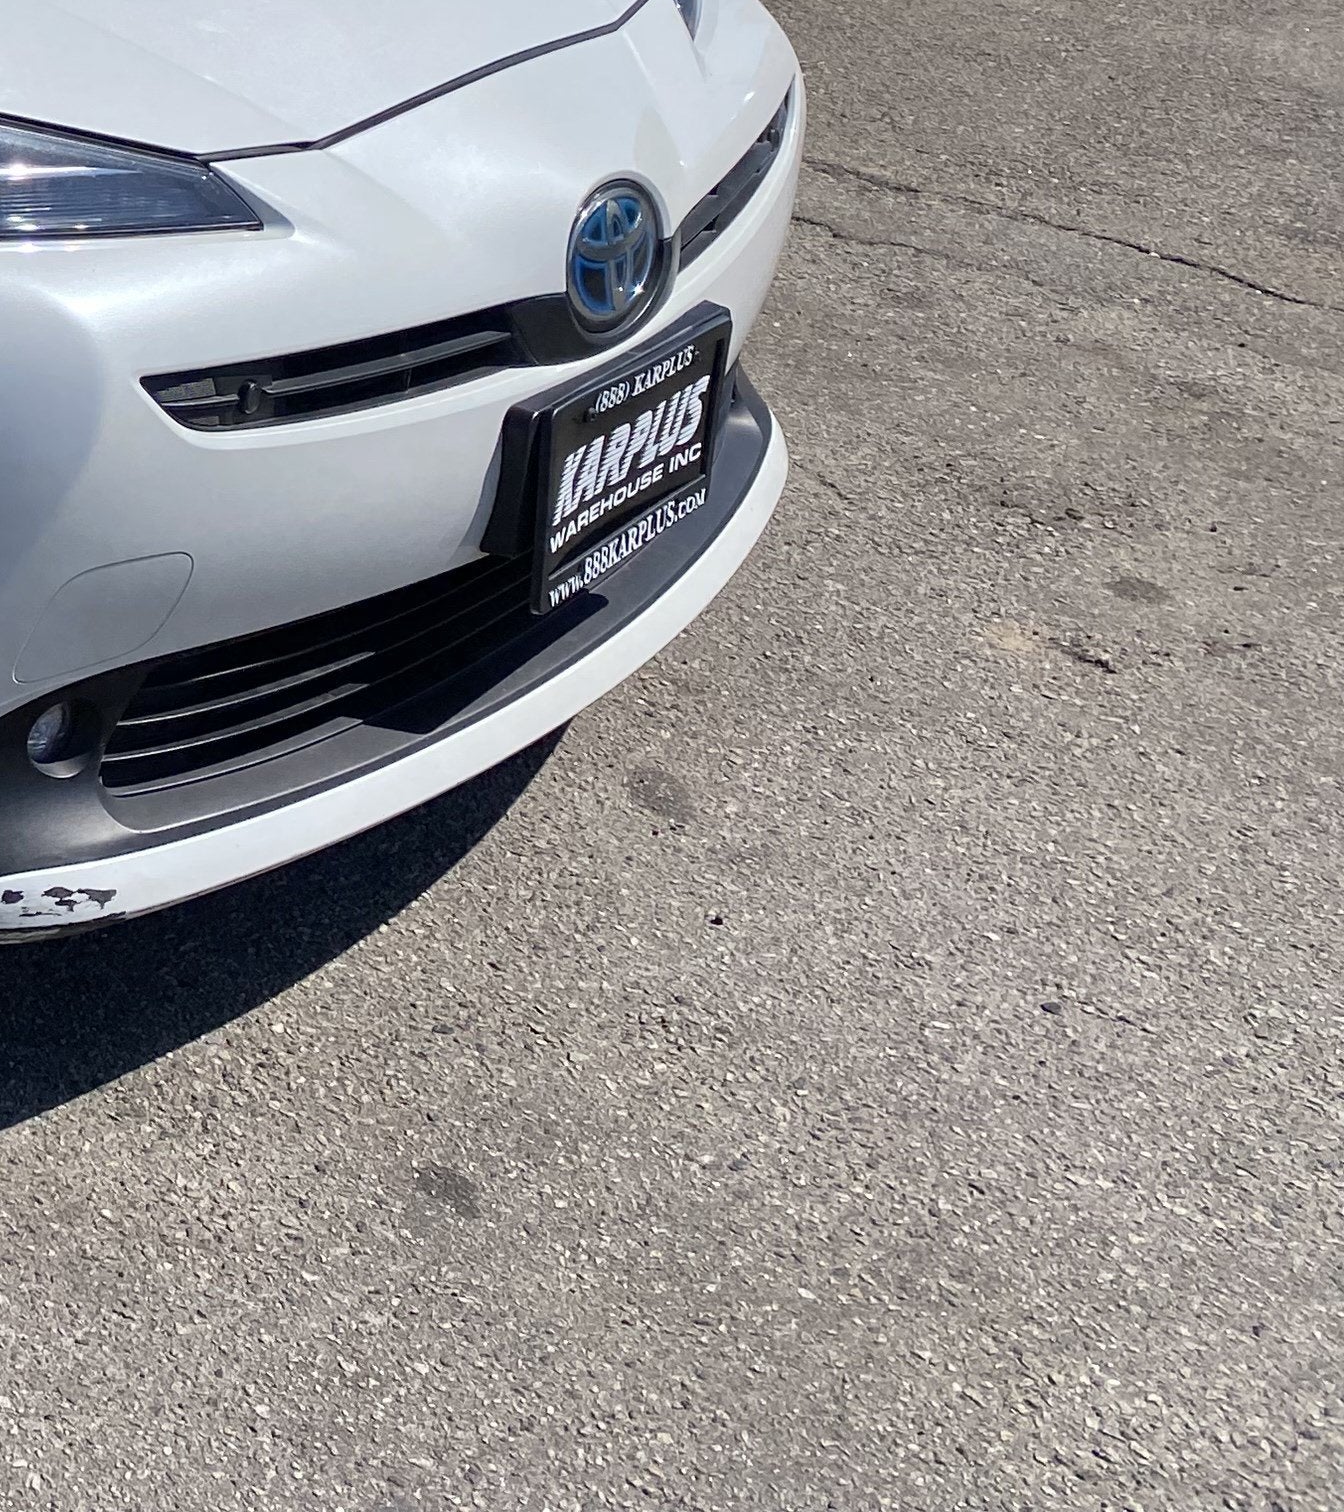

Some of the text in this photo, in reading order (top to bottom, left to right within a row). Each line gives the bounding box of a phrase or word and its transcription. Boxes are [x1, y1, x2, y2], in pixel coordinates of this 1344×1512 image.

[595, 345, 695, 414] (888) KARPLUS
[549, 442, 703, 554] WAREHOUSE INC
[552, 374, 711, 527] KARPLUS
